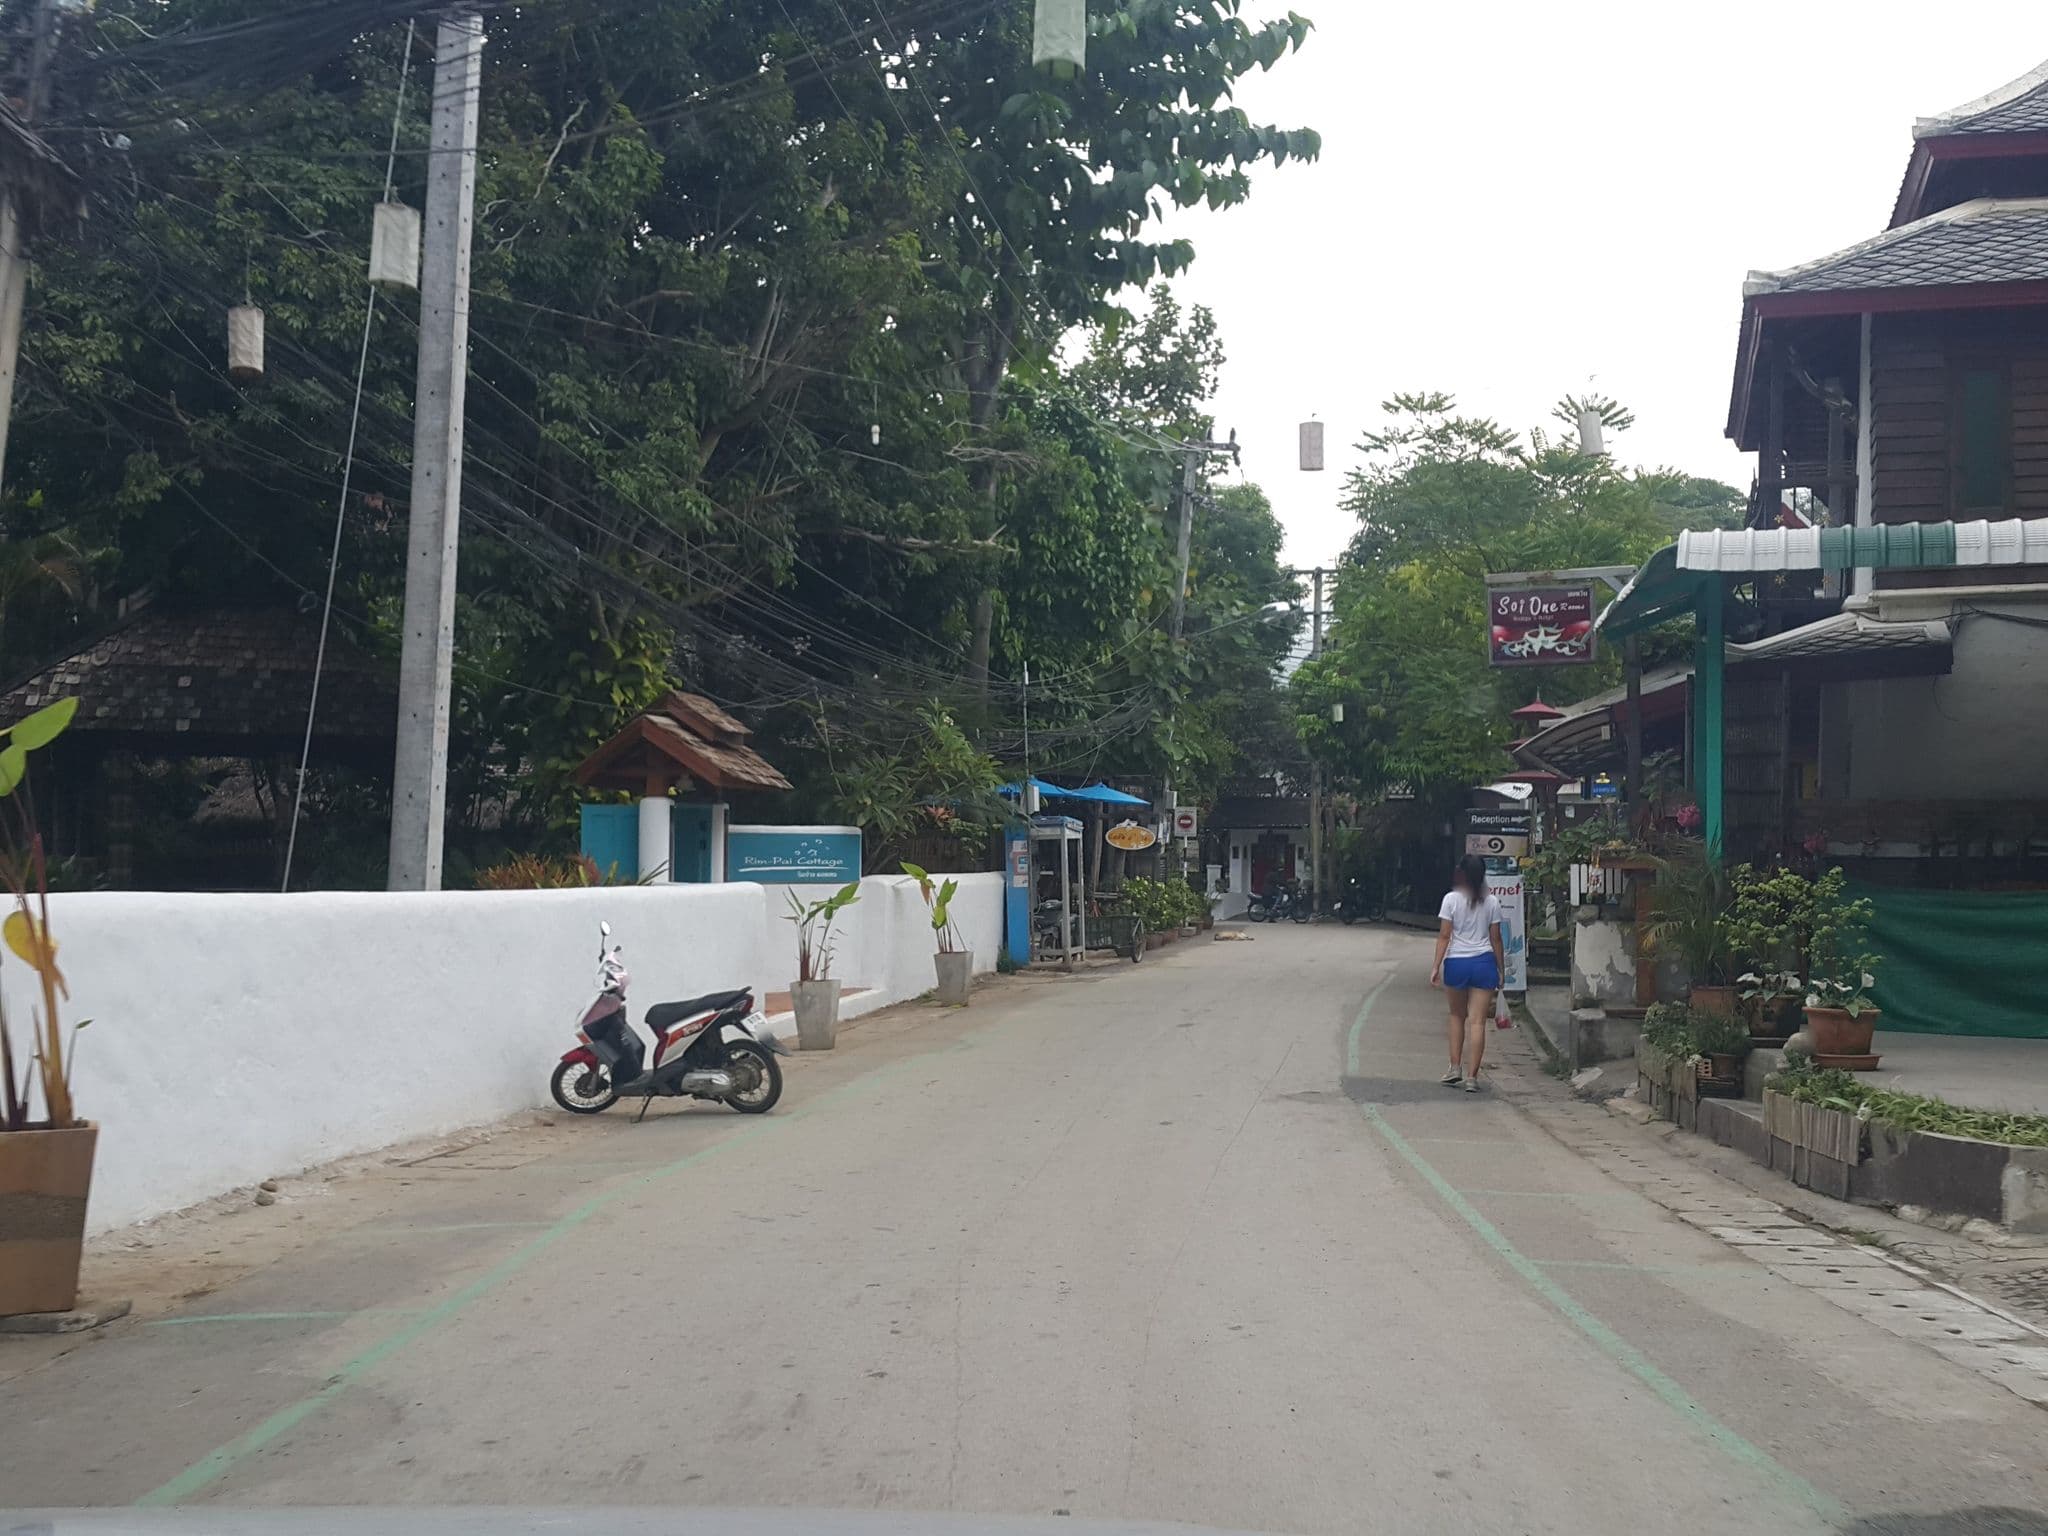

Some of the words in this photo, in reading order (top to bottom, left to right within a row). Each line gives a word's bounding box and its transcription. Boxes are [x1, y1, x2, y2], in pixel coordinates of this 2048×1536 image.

[1497, 596, 1525, 615] Soi
[1529, 596, 1559, 616] One
[1471, 815, 1510, 824] Reception
[797, 856, 844, 867] Cottage
[1488, 883, 1520, 896] ernet
